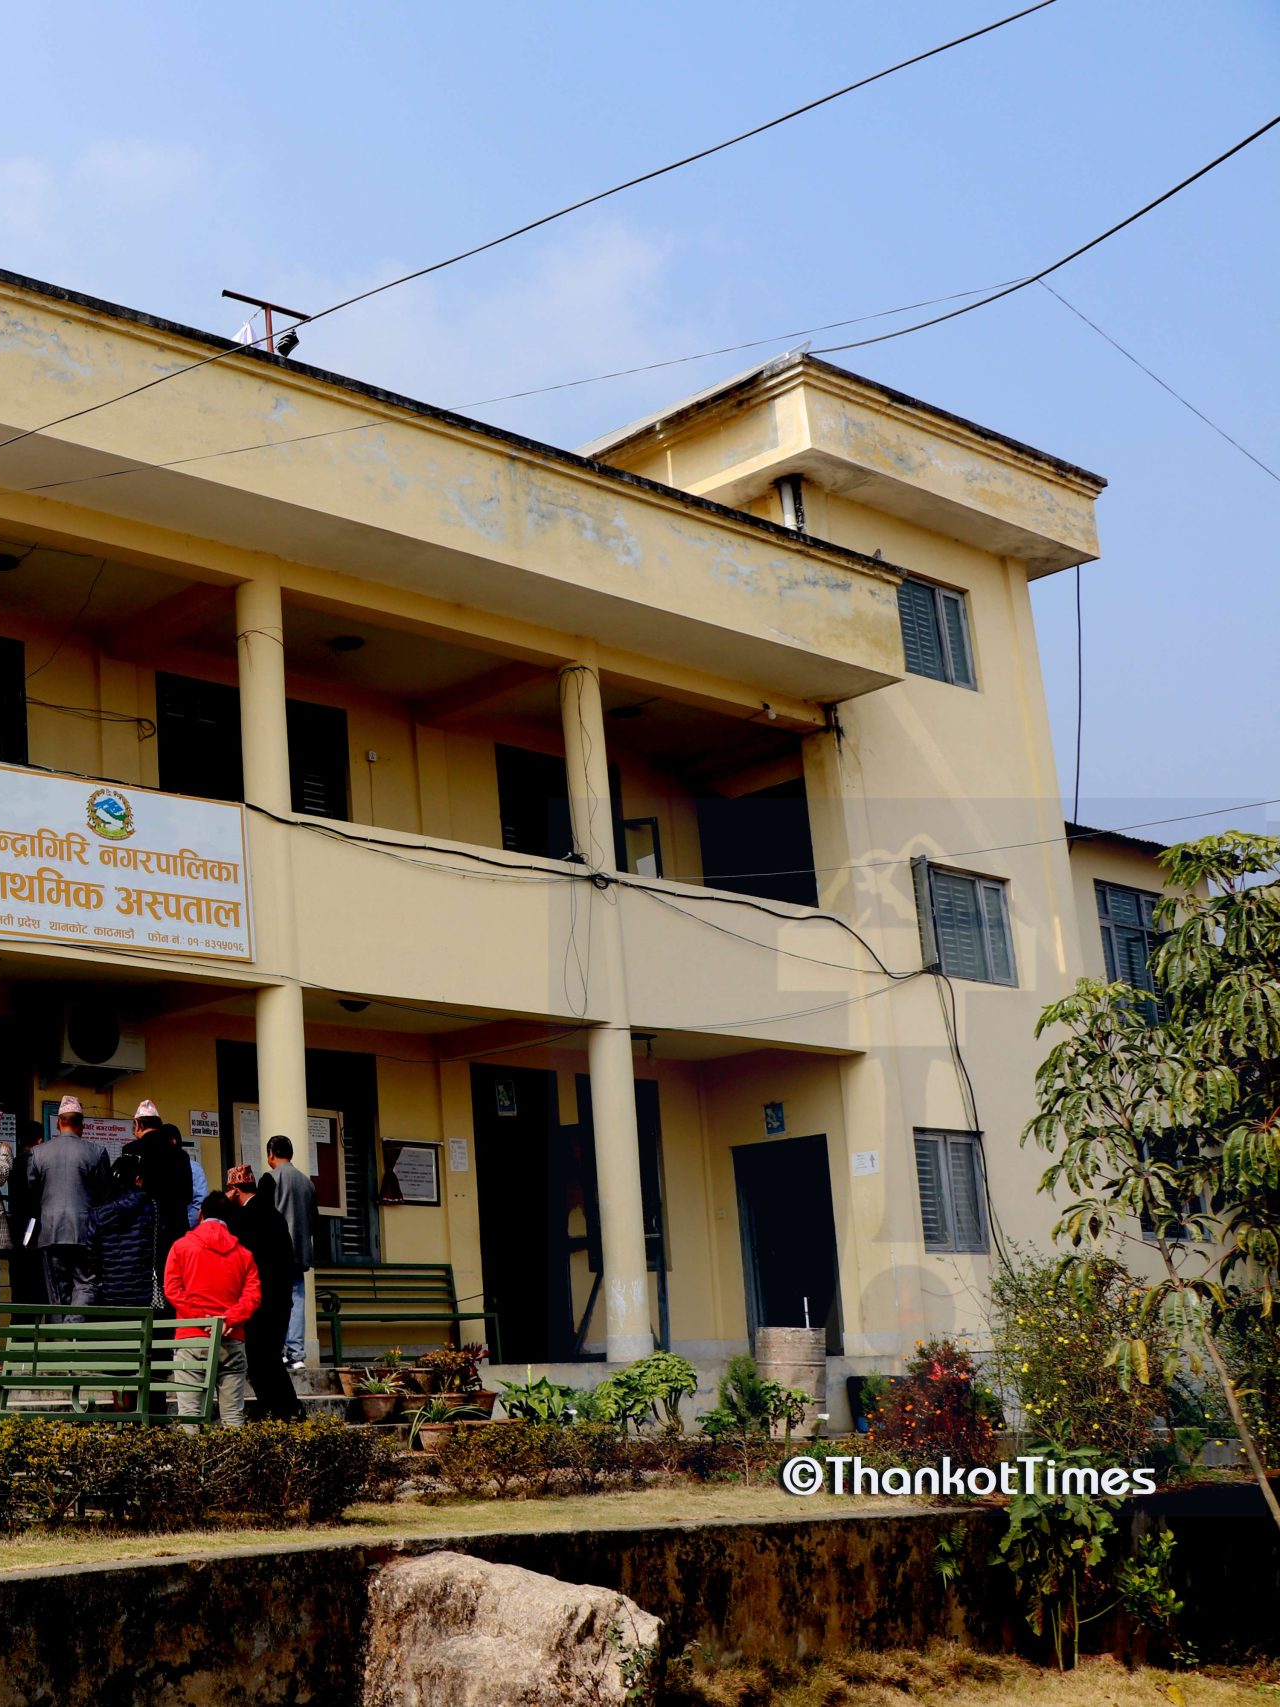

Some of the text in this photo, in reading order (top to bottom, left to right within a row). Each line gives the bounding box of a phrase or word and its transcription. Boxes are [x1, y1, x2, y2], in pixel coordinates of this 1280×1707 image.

[98, 844, 239, 884] नगरपालिका
[115, 885, 241, 928] अस्पताल
[147, 931, 169, 944] फोन
